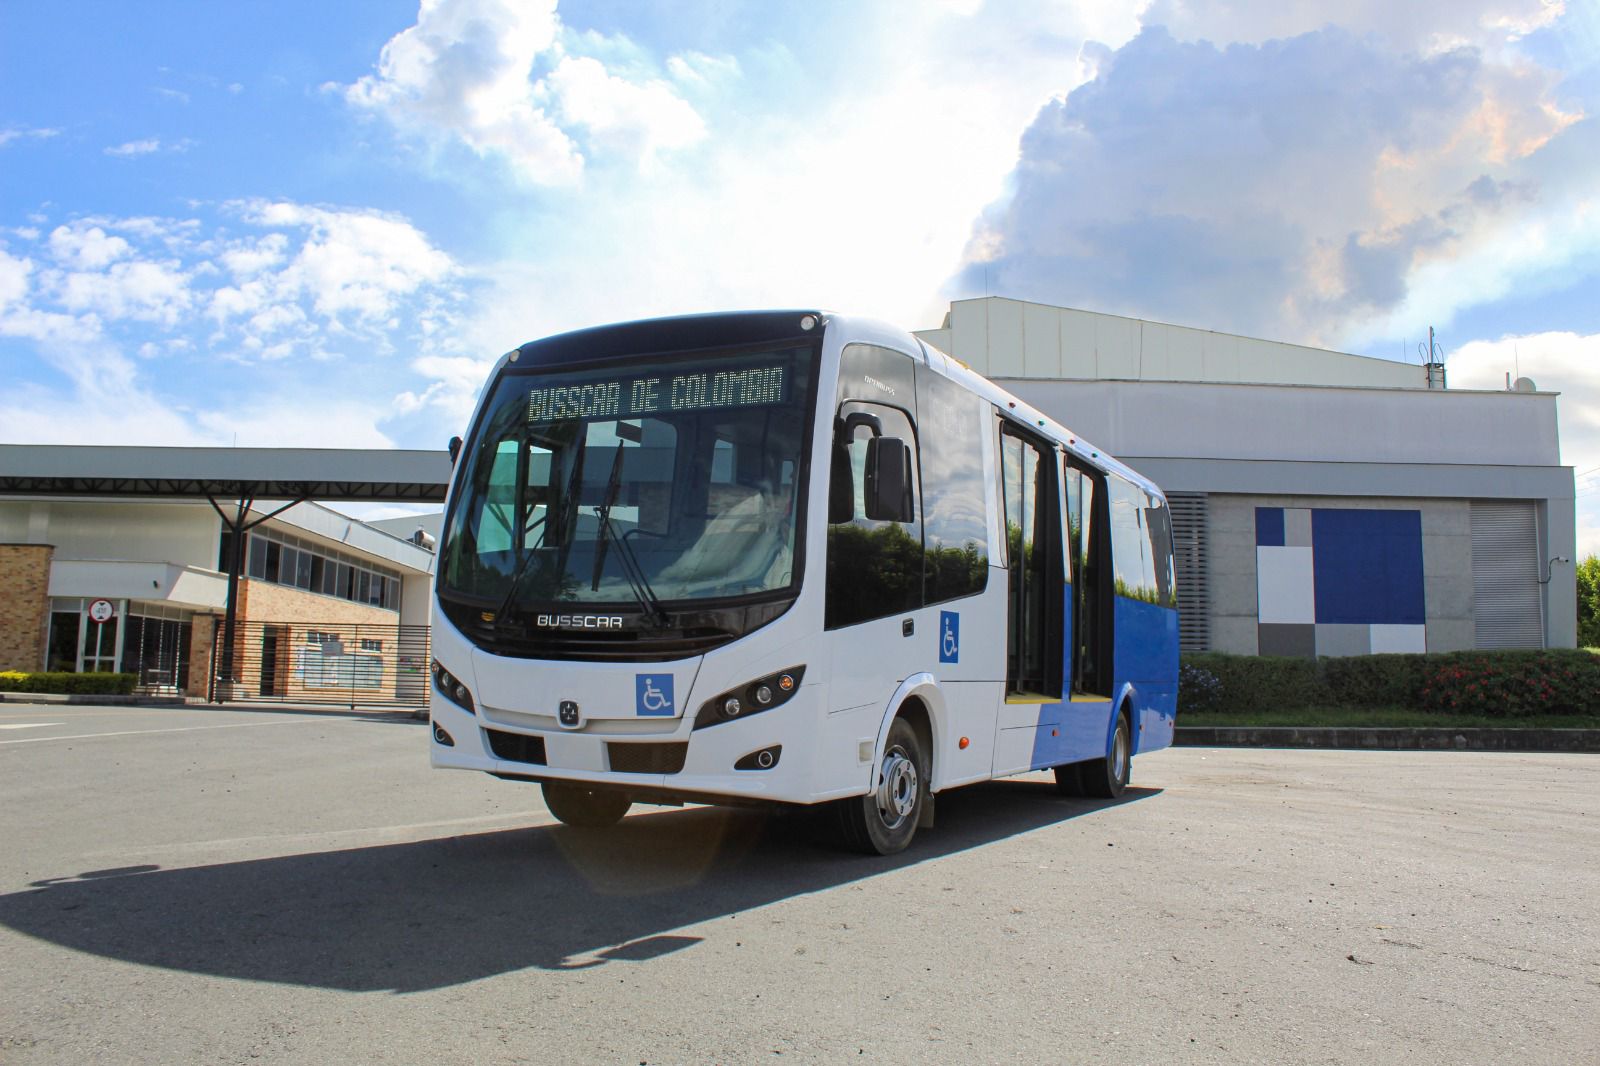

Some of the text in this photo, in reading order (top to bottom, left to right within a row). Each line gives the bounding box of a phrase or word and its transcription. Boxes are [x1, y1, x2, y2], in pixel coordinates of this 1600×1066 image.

[528, 367, 783, 422] BUSSCAR DE COLOMBIA
[537, 614, 623, 628] BUSSCAR
